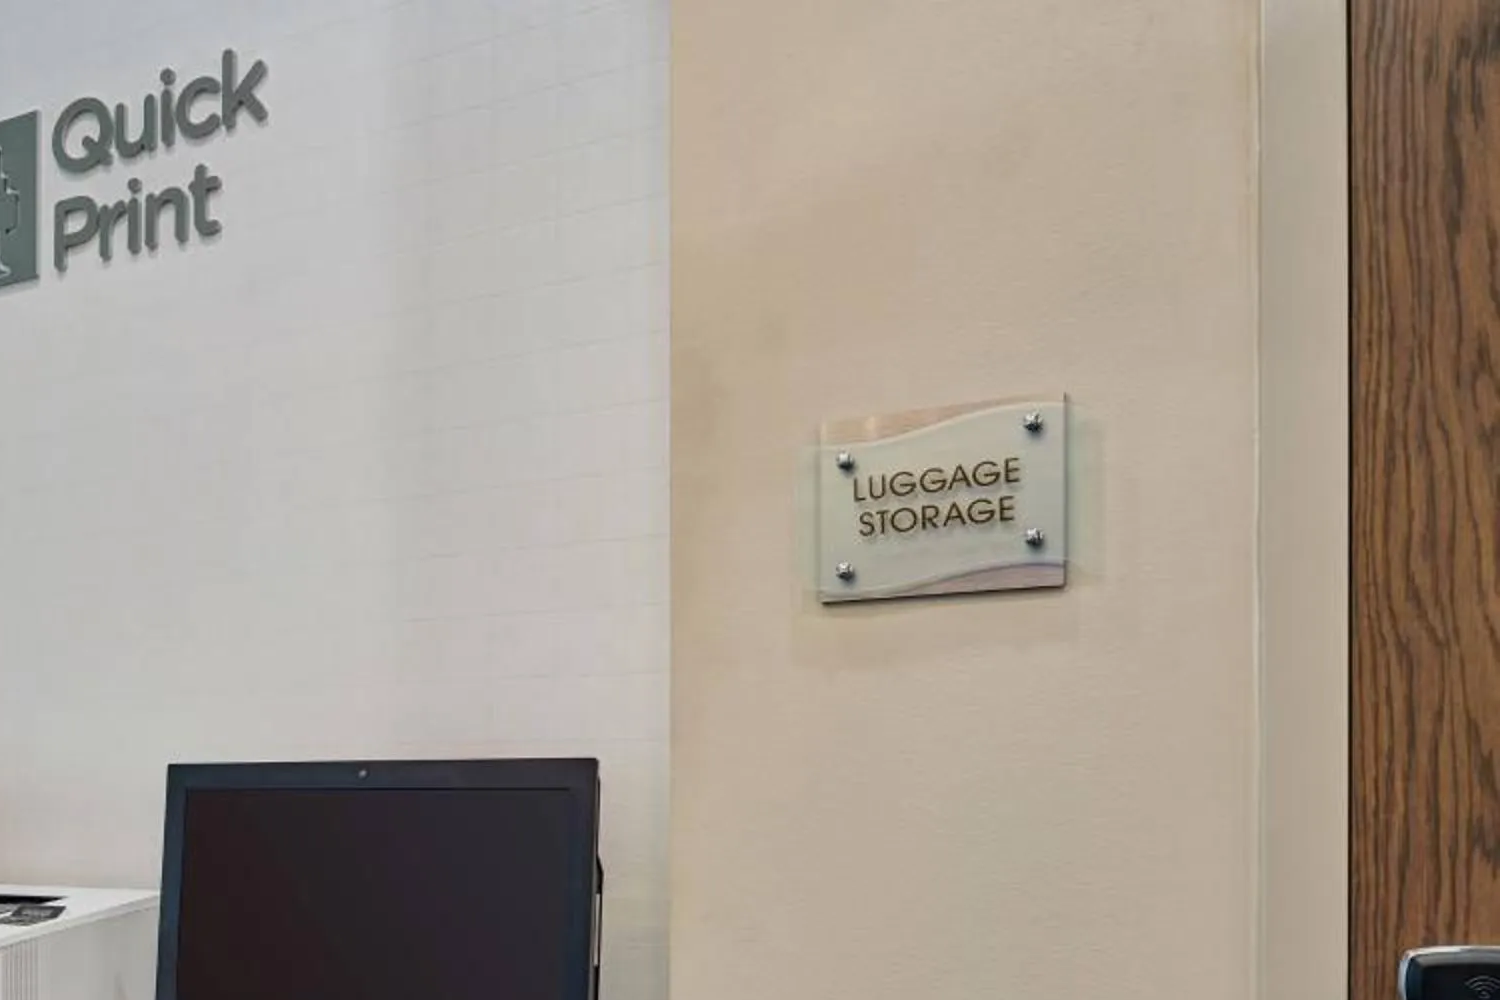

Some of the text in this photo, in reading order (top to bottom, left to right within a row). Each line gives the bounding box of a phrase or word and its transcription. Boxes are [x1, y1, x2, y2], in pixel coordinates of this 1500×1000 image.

[52, 49, 269, 172] Quick
[53, 163, 222, 272] Print
[853, 457, 1021, 503] LUGGAGE
[858, 495, 1015, 537] STORAGE
